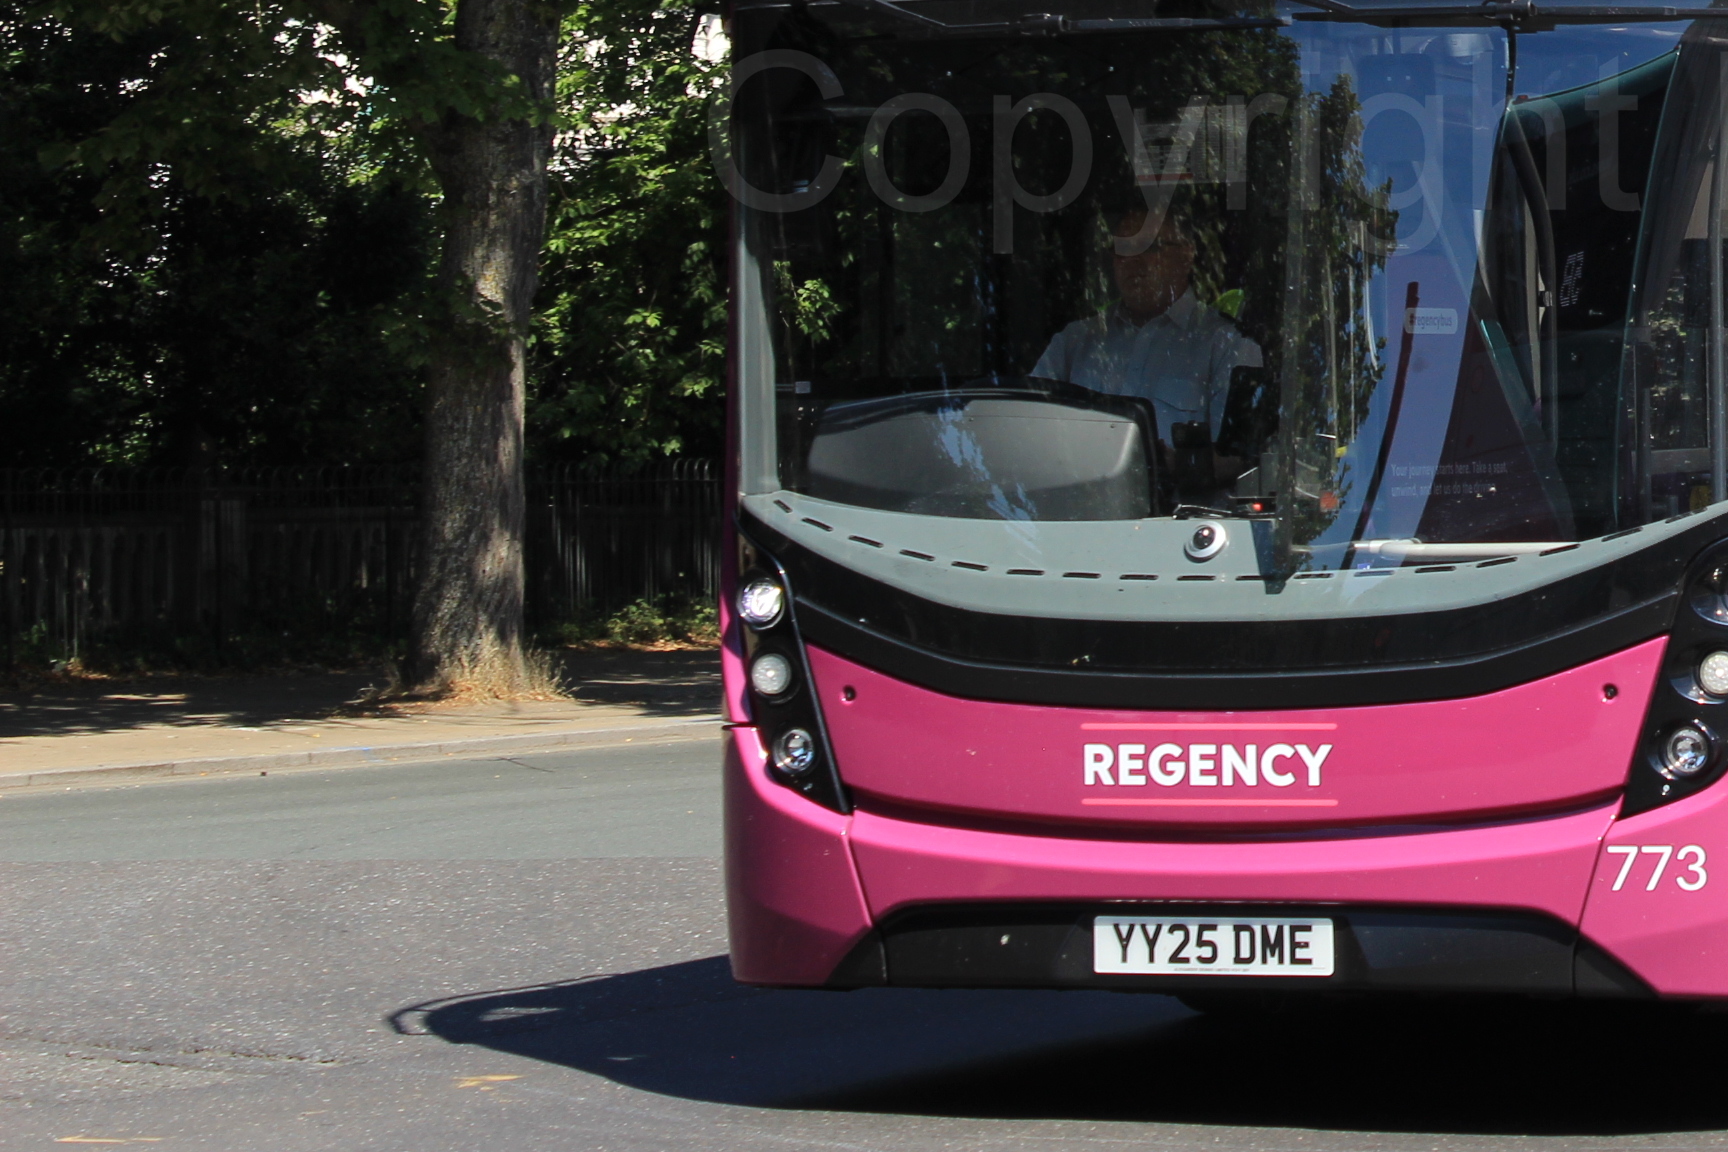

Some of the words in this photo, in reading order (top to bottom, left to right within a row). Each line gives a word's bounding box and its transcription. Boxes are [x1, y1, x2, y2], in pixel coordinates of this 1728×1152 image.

[1083, 743, 1333, 786] REGENCY
[1607, 844, 1707, 891] 773
[1113, 923, 1219, 964] YY25
[1233, 924, 1313, 965] DME
